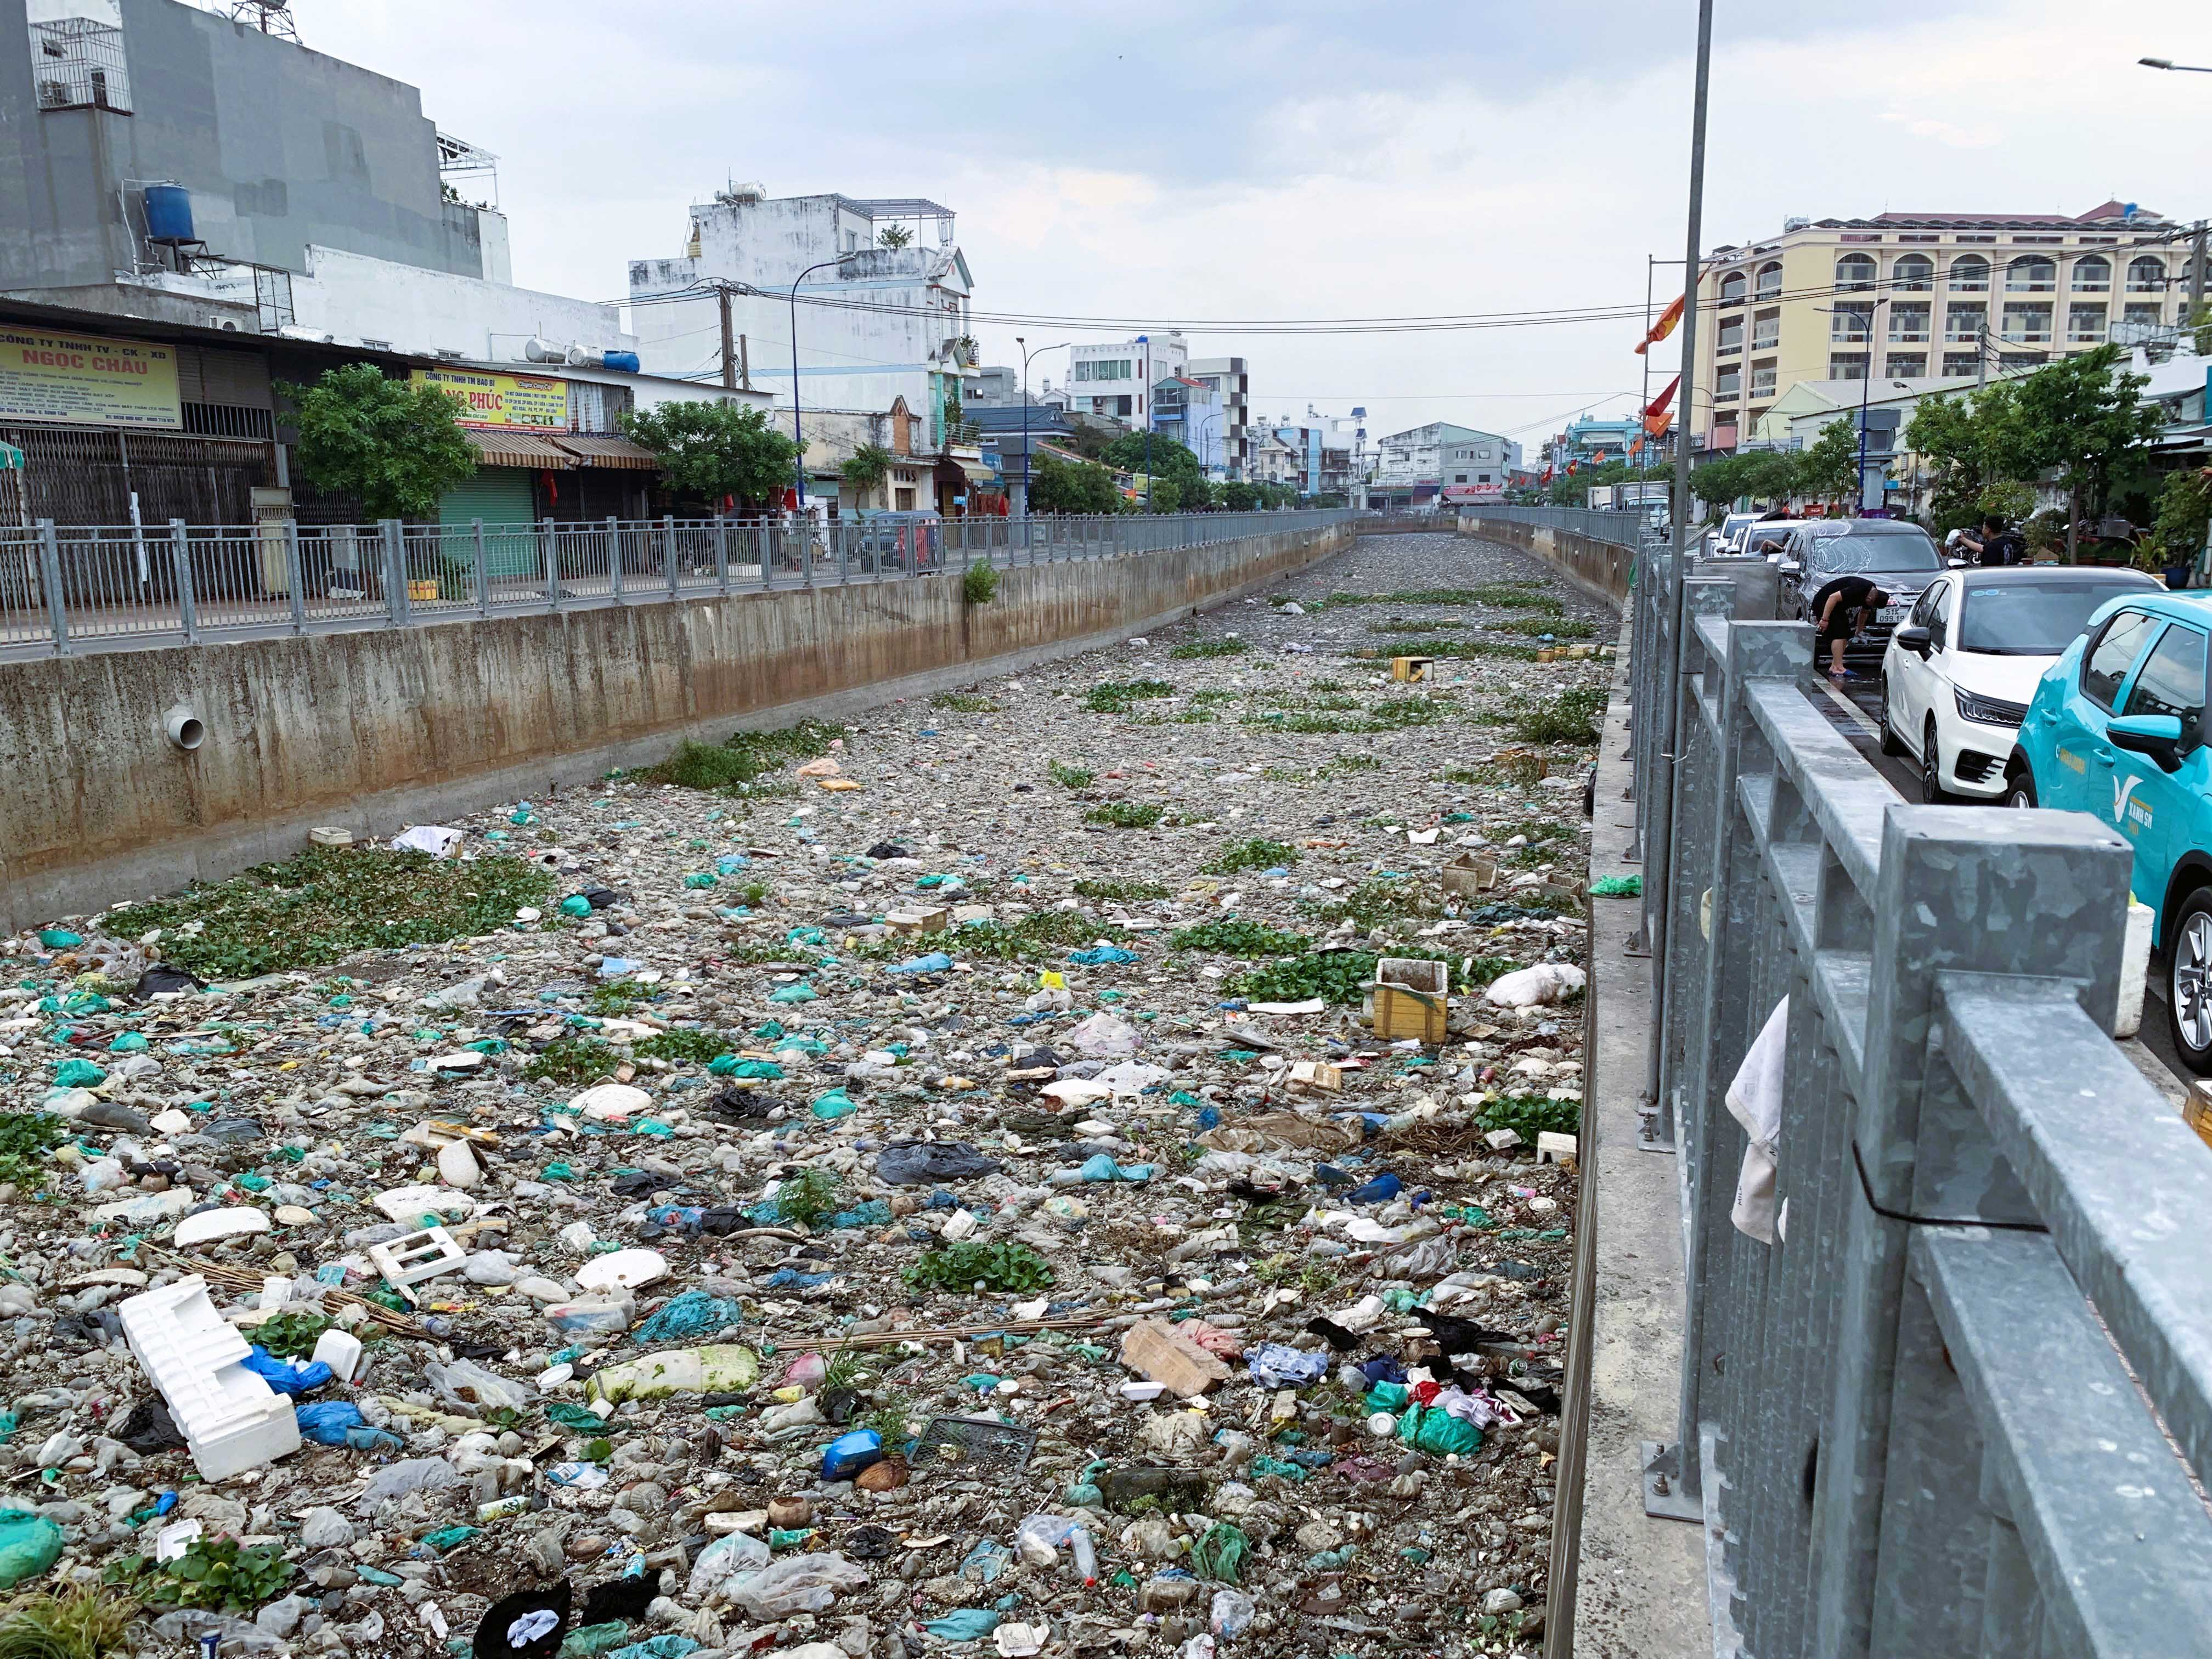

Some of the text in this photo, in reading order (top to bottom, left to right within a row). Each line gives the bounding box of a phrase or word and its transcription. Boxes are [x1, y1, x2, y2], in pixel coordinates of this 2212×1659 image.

[0, 334, 34, 345] CÔNG
[39, 338, 53, 347] TY
[58, 341, 91, 351] TNHH
[22, 349, 148, 375] NGỌC CHÂU
[426, 371, 442, 380] CÔNG
[451, 375, 466, 383] TNHH
[477, 378, 488, 386] BAO
[469, 389, 503, 410] PHÚC
[2129, 802, 2153, 830] XANH SM
